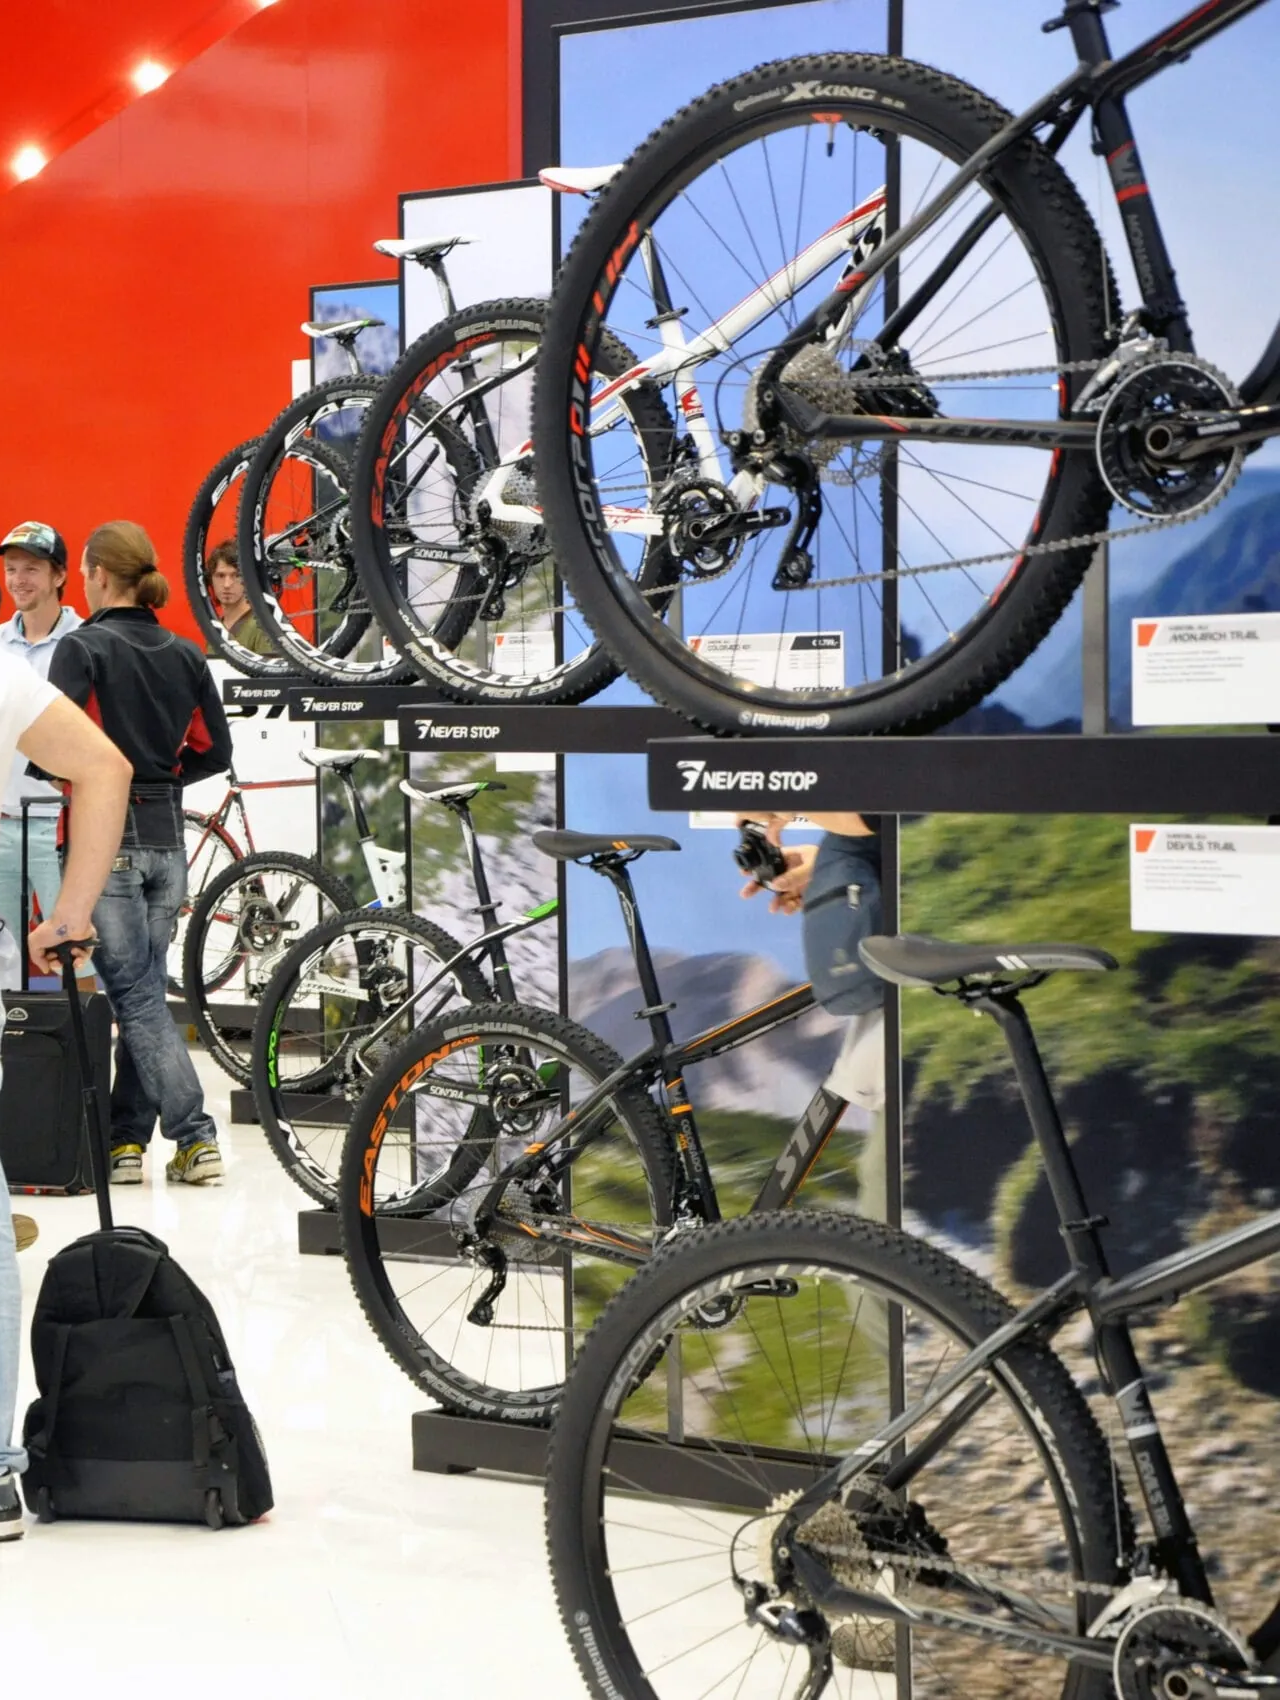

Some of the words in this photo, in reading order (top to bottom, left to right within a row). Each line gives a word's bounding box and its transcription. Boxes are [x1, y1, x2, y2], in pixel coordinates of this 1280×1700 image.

[371, 338, 469, 527] EASTON
[414, 547, 448, 560] SONORA
[1169, 631, 1227, 642] MONARCH
[1230, 630, 1260, 640] TRAIL
[404, 641, 477, 691] ROCKET
[417, 636, 593, 687] EASTON
[240, 689, 262, 698] NEVER
[263, 689, 281, 698] STOP
[312, 702, 340, 712] NEVER
[341, 701, 363, 711] STOP
[430, 727, 468, 739] NEVER
[470, 727, 500, 739] STOP
[702, 771, 764, 791] NEVER
[768, 771, 818, 792] STOP
[1167, 840, 1204, 851] DEVILS
[1207, 841, 1237, 852] TRAIL
[307, 983, 346, 994] STEVENS
[443, 1022, 569, 1051] SCHWALBE
[268, 1031, 278, 1088] EA70
[429, 1085, 464, 1100] SONORA
[359, 1044, 451, 1217] EASTON
[681, 1119, 702, 1172] COLORADO
[419, 1368, 496, 1416] ROCKET
[501, 1407, 545, 1419] RON
